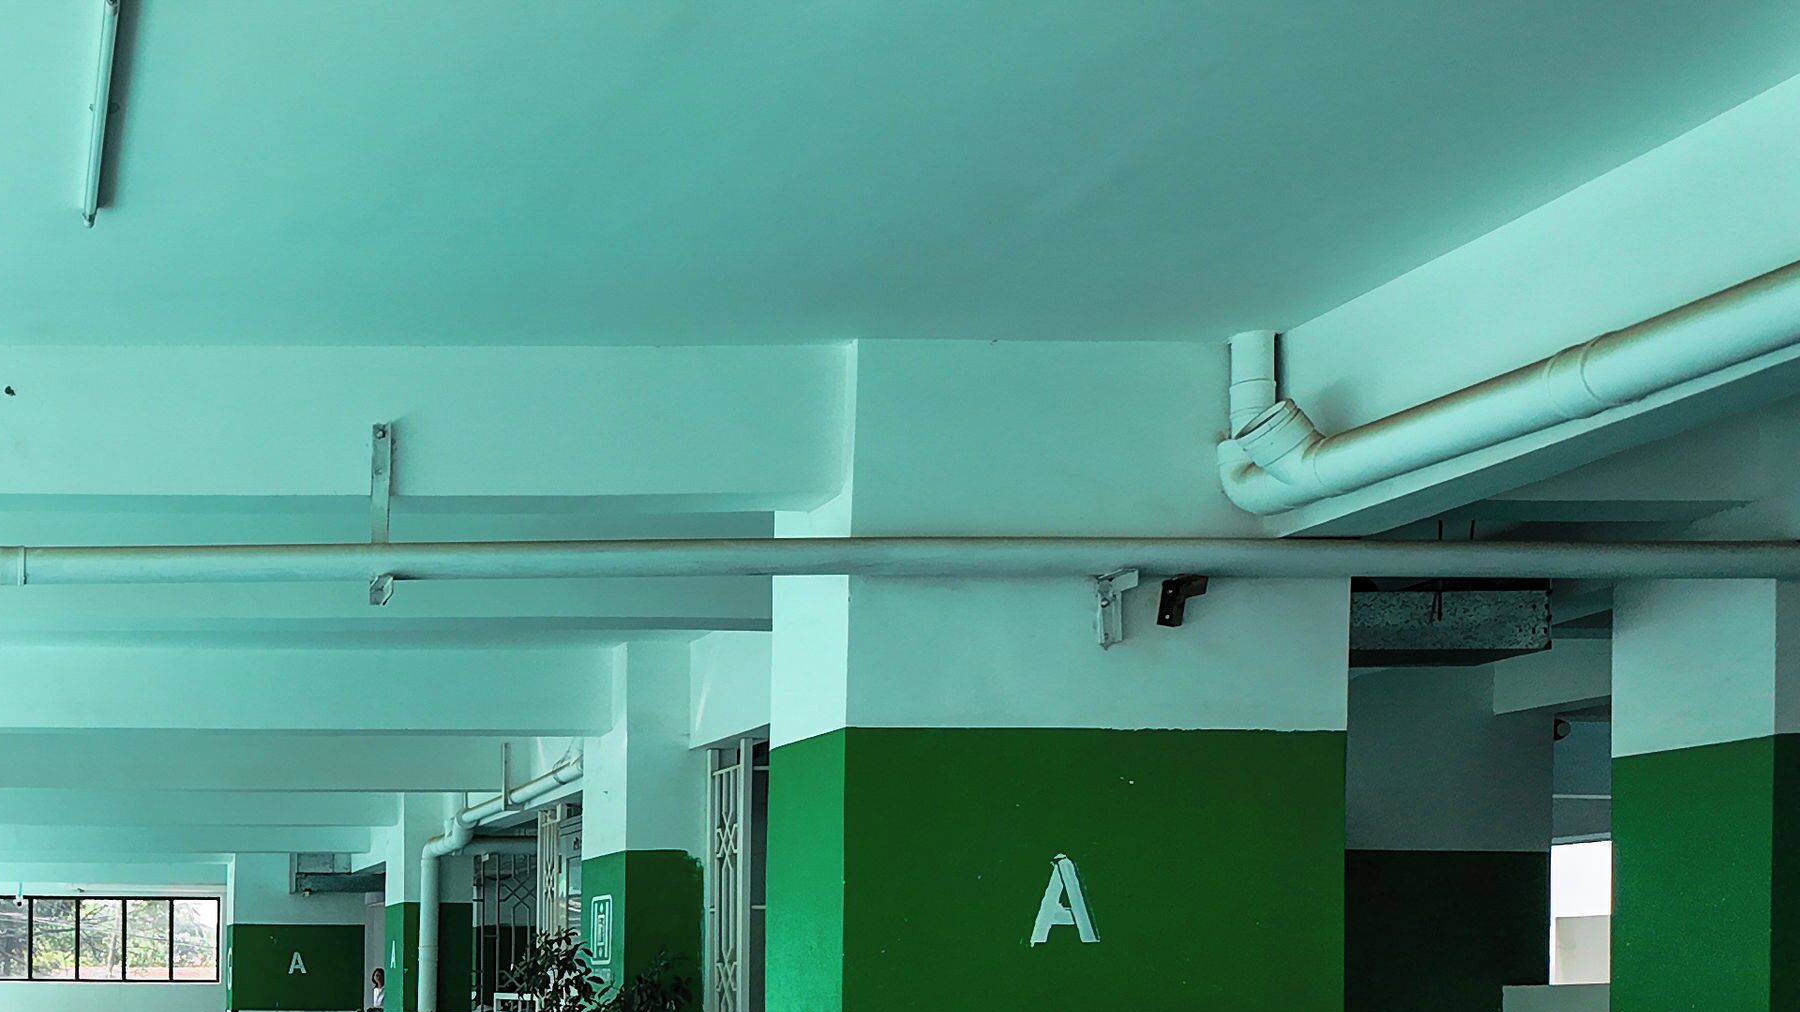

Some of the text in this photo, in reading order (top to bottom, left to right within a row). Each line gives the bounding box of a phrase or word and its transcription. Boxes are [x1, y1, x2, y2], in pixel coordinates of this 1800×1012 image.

[1030, 853, 1101, 948] A
[289, 953, 306, 975] A
[390, 940, 396, 969] A
